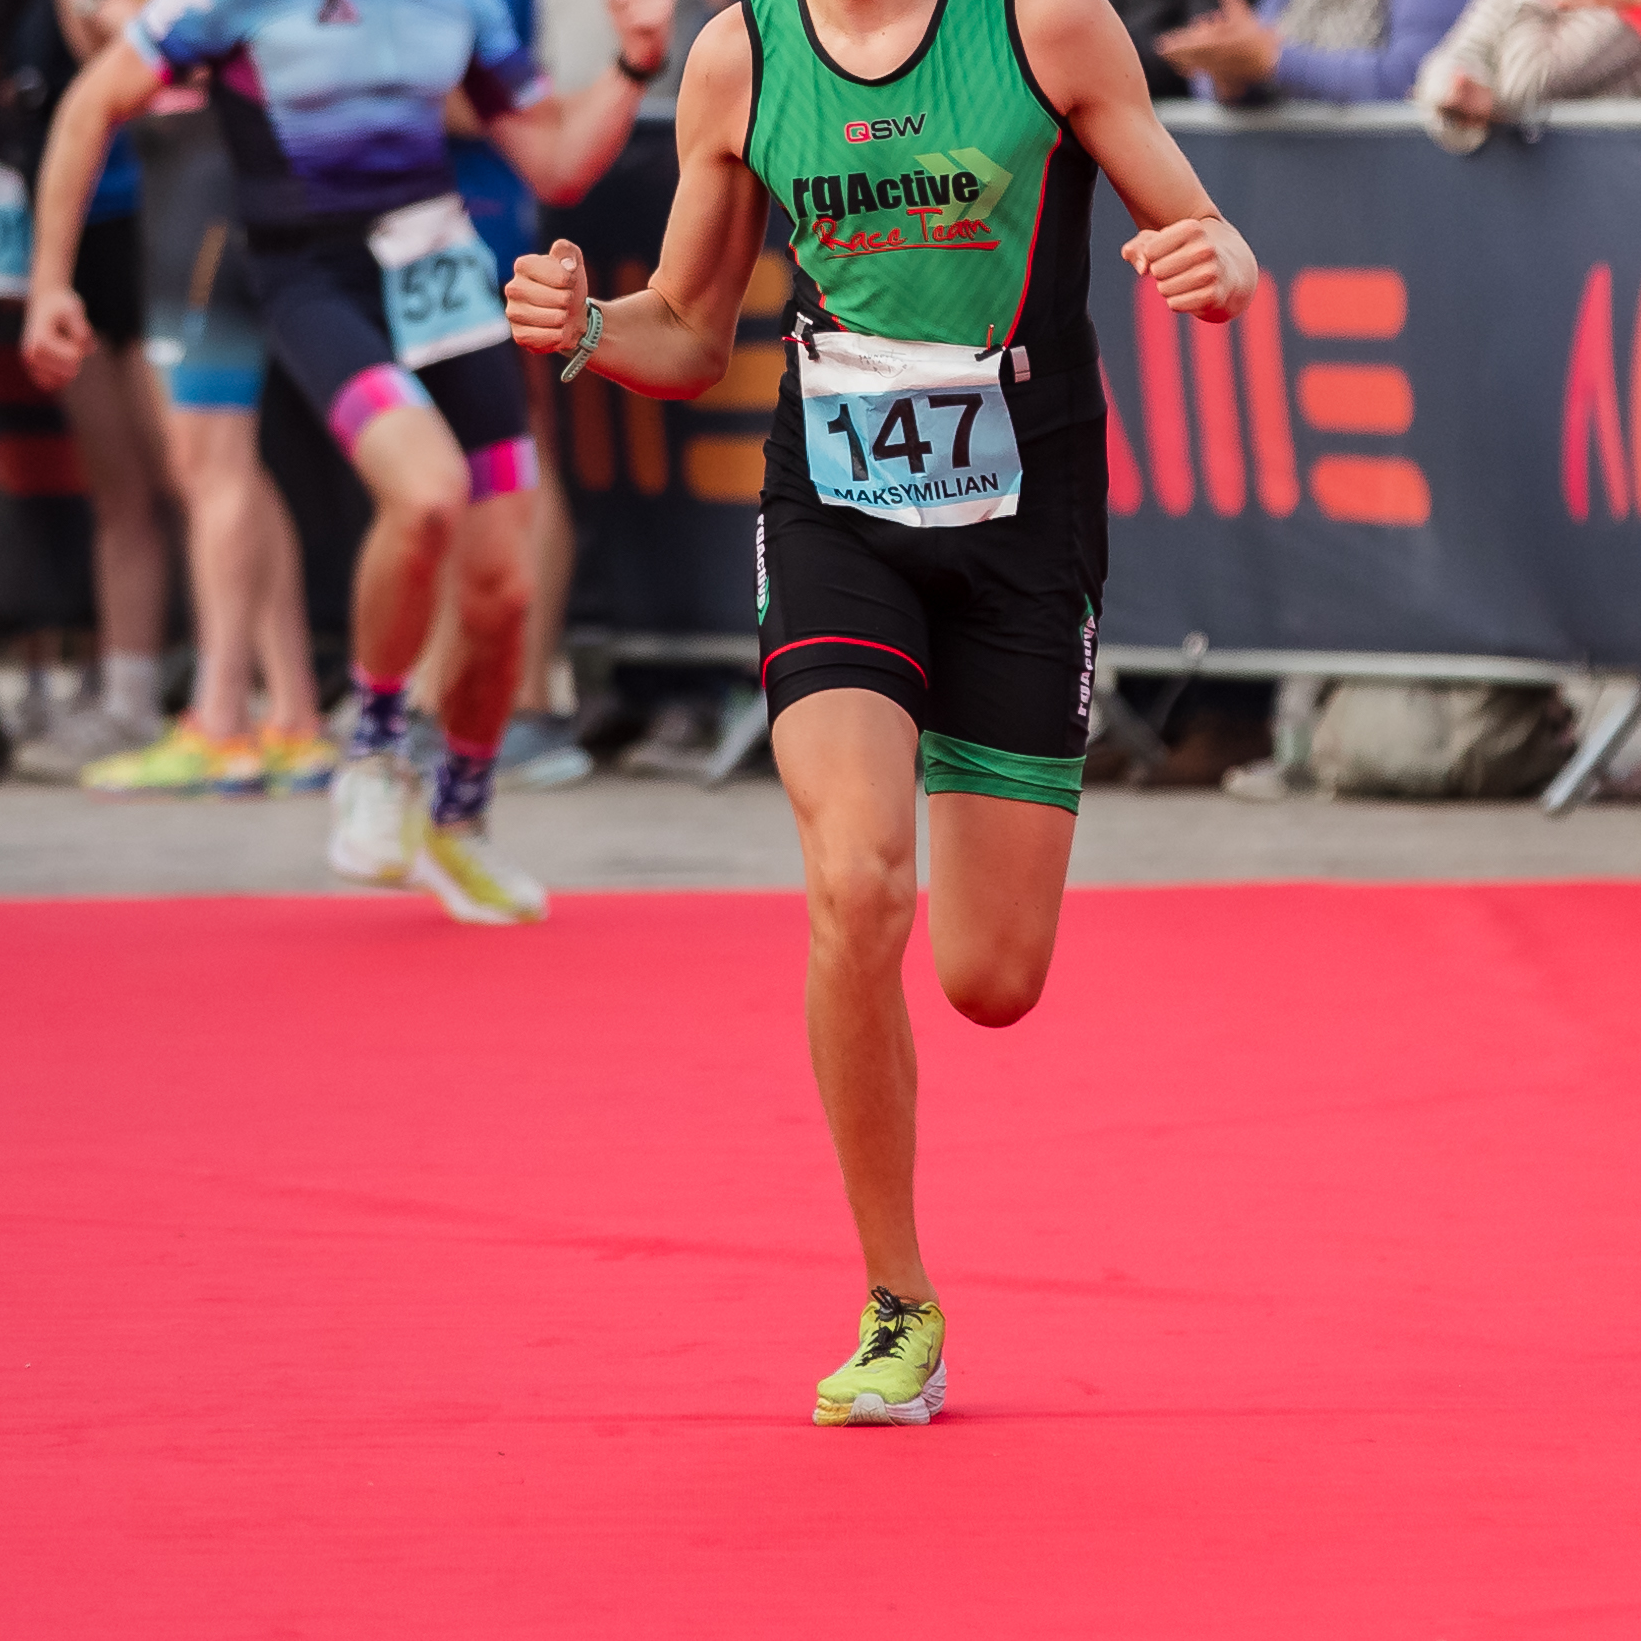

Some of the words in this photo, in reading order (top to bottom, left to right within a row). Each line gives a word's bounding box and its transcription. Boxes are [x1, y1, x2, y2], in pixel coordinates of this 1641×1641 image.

[844, 112, 927, 144] QSW
[792, 169, 980, 222] rgActive
[812, 217, 907, 251] Race
[906, 206, 992, 242] Team
[826, 392, 984, 483] 147
[833, 472, 1000, 506] MAKSYMILIAN
